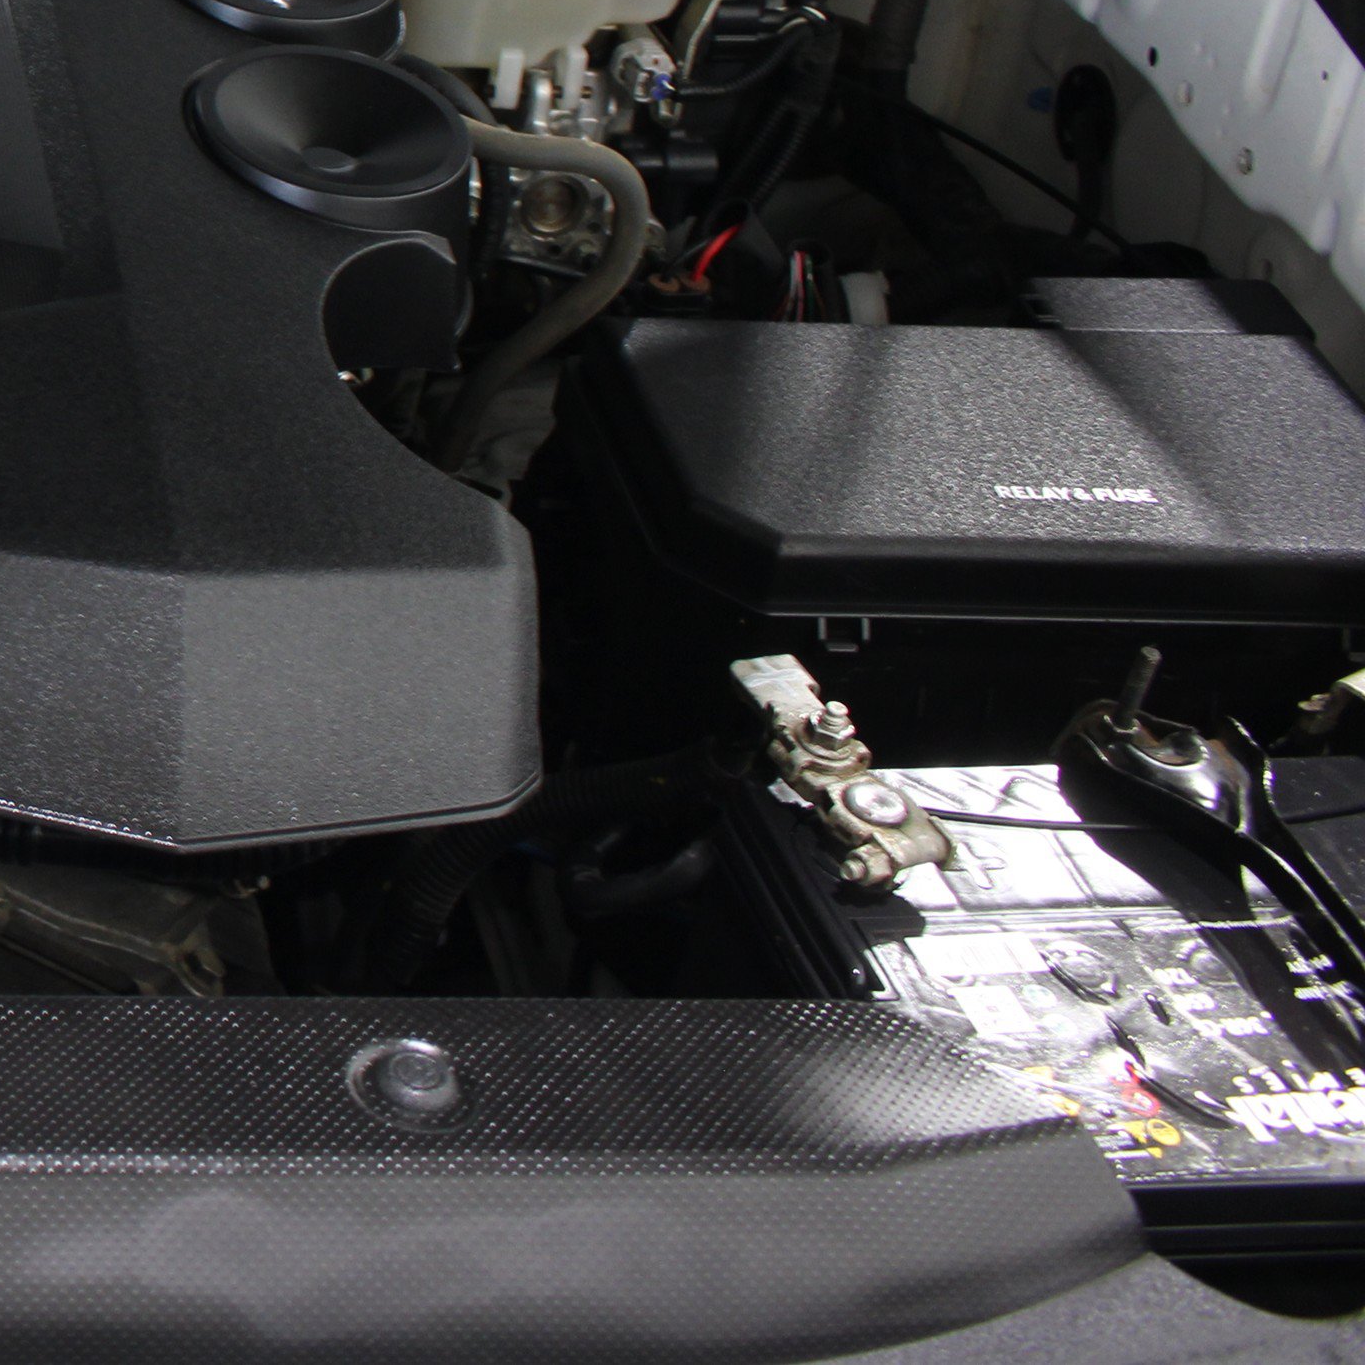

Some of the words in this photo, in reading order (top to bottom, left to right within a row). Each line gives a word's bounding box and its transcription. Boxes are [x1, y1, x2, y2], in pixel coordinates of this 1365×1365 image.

[993, 485, 1073, 502] RELAY
[1073, 488, 1093, 502] &
[1093, 487, 1160, 504] FUSE
